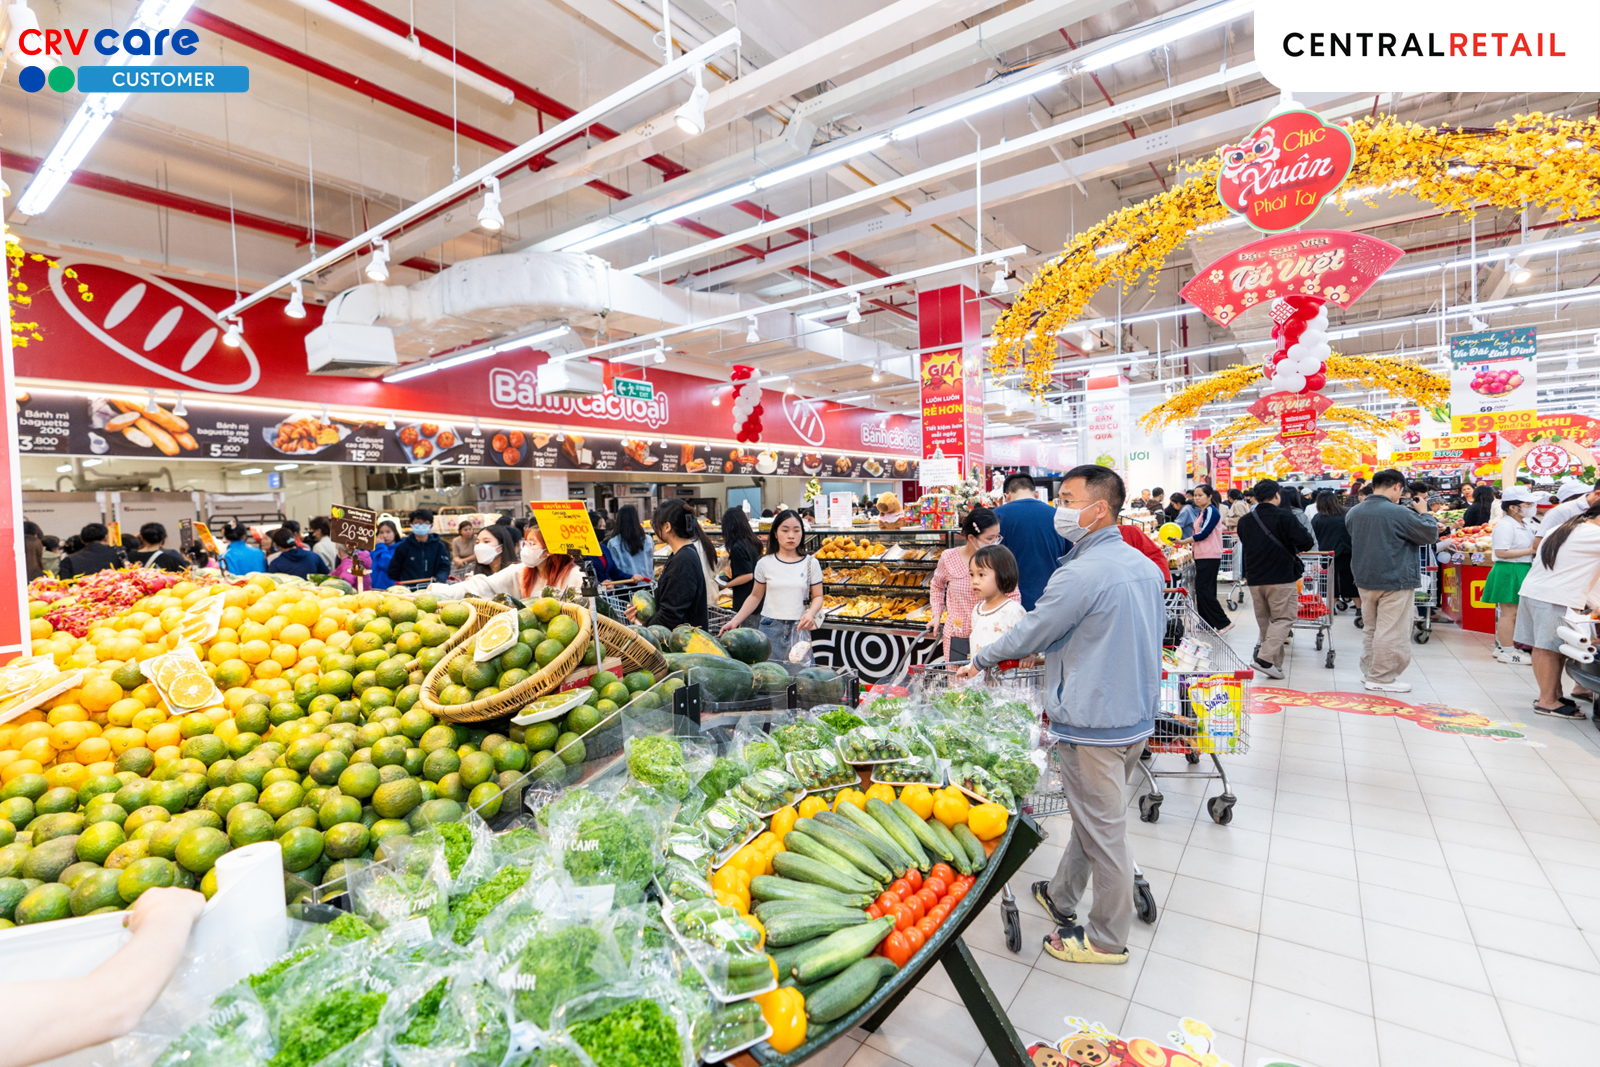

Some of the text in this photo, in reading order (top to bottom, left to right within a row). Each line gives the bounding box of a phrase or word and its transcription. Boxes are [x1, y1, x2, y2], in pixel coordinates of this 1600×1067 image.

[1283, 128, 1326, 151] Chúc
[1238, 152, 1333, 206] Xuân
[1254, 190, 1317, 216] Phát Tài
[1229, 248, 1345, 292] Tết Việt
[926, 359, 956, 378] GIÁ
[25, 410, 53, 419] Bánh
[923, 403, 963, 417] RẺ HƠN
[20, 417, 70, 428] baguette
[1460, 413, 1531, 433] 39.900
[1537, 417, 1571, 428] KHU
[40, 427, 70, 436] 200g
[1561, 425, 1588, 438] TẾT
[1130, 451, 1149, 461] ƯƠI
[1531, 446, 1565, 457] APPLE
[1531, 464, 1564, 474] WEEK
[479, 486, 494, 500] 01
[615, 484, 627, 497] 07
